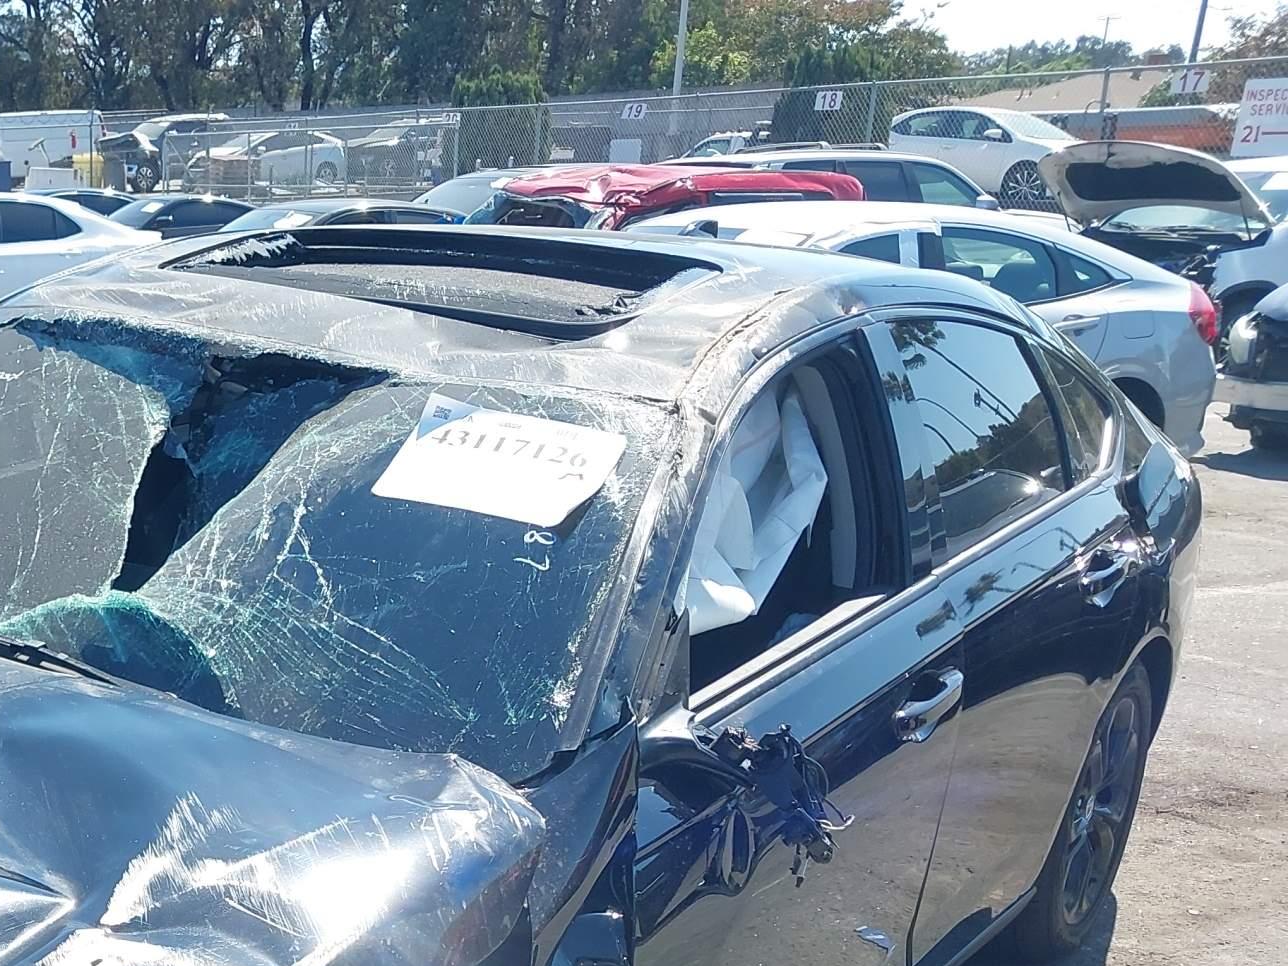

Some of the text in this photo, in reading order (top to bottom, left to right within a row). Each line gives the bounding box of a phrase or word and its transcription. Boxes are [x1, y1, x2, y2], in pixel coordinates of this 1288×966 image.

[1179, 71, 1205, 92] 17
[820, 92, 837, 108] 18
[627, 104, 643, 118] 19
[1250, 103, 1288, 117] SERVI
[1240, 125, 1262, 143] 21
[431, 428, 588, 468] 43117126
